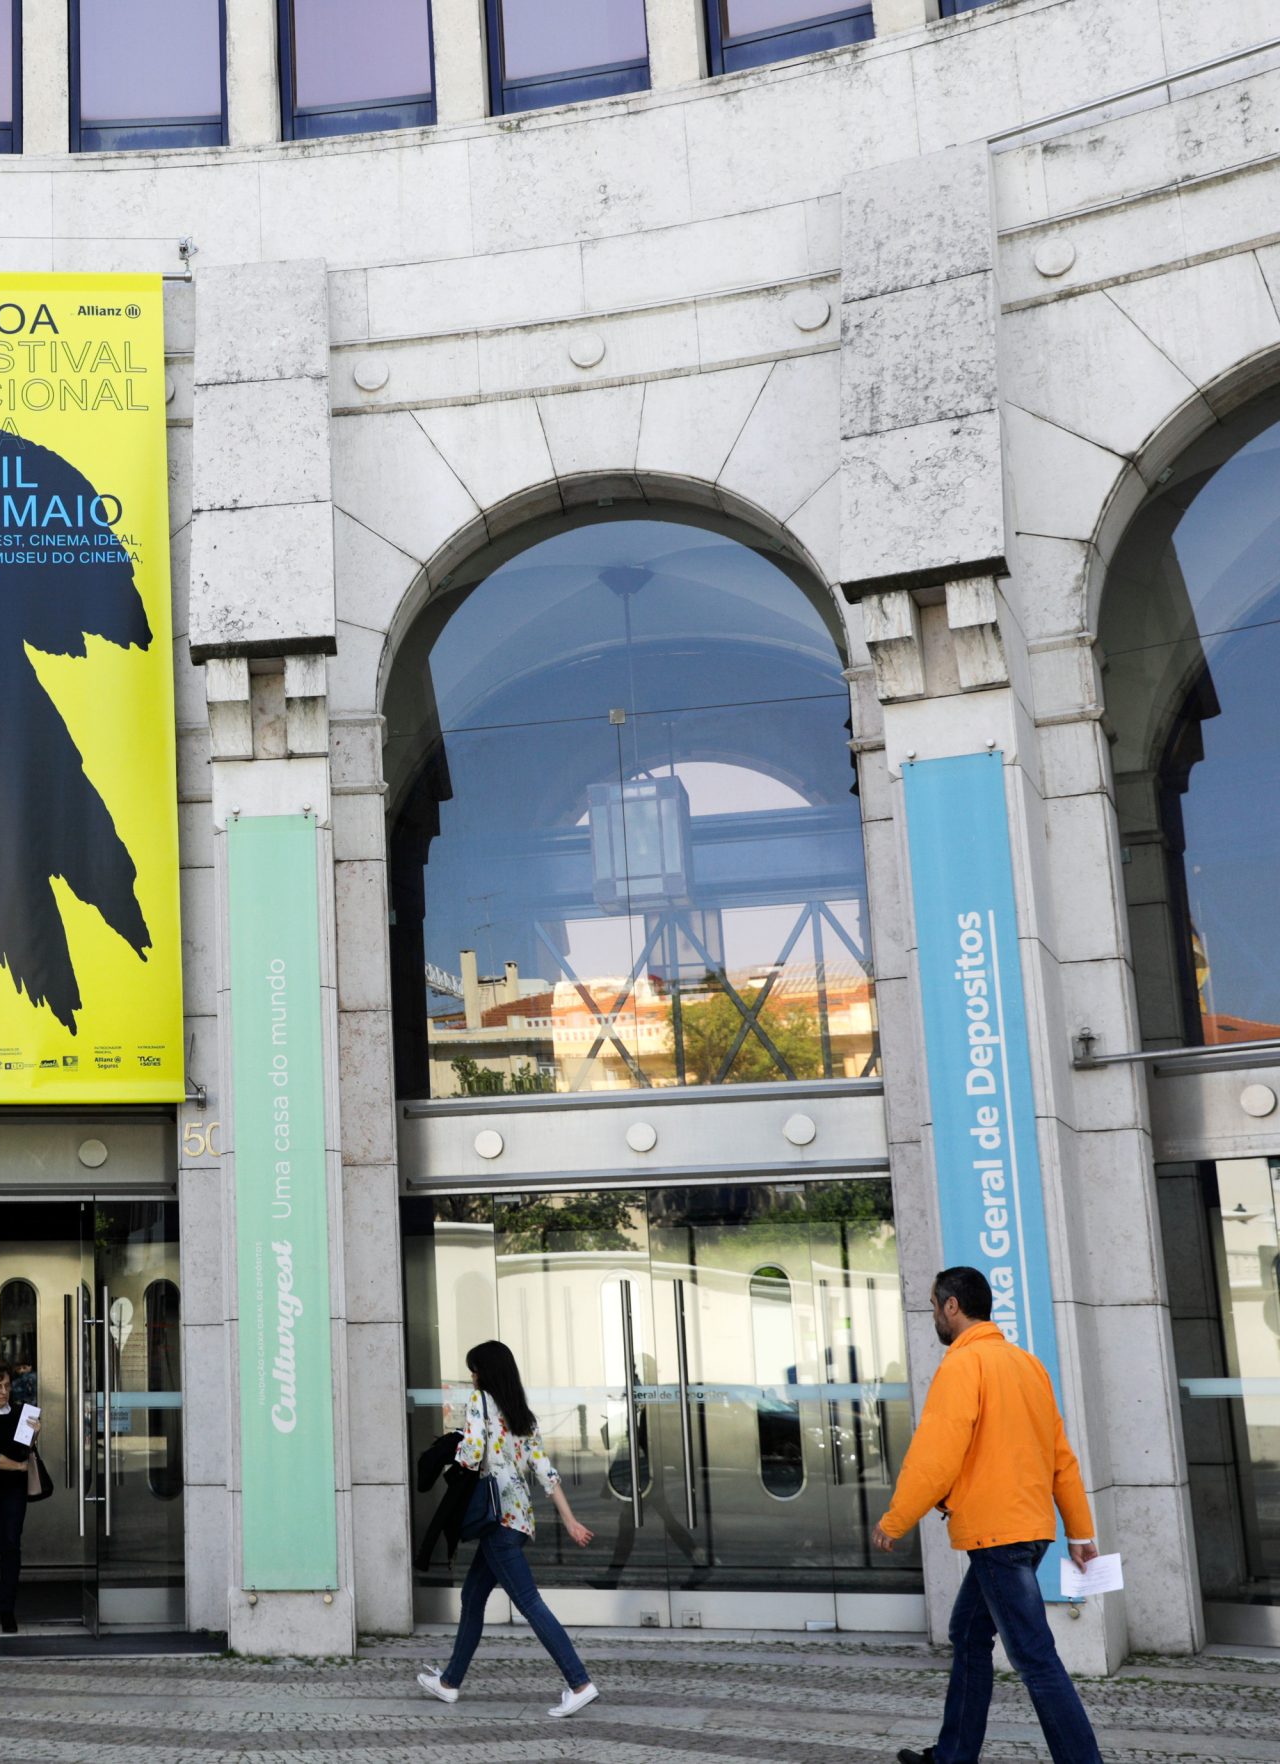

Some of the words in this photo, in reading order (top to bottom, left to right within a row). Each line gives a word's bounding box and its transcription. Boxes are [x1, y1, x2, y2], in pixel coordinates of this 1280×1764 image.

[78, 305, 122, 316] Allianz
[3, 494, 123, 528] MAIO
[29, 534, 90, 547] CINEMA
[93, 534, 142, 547] IDEAL,
[52, 552, 75, 564] DO
[79, 551, 144, 564] CINEMA,
[266, 958, 287, 1045] mundo
[268, 1054, 288, 1087] do
[272, 1095, 290, 1152] casa
[970, 1106, 1002, 1149] de
[272, 1160, 292, 1219] Uma
[973, 1160, 1010, 1258] Geral
[257, 1289, 263, 1301] DE
[989, 1266, 1019, 1347] aixa
[257, 1331, 265, 1358] CAIXA
[271, 1239, 303, 1434] Culturgest
